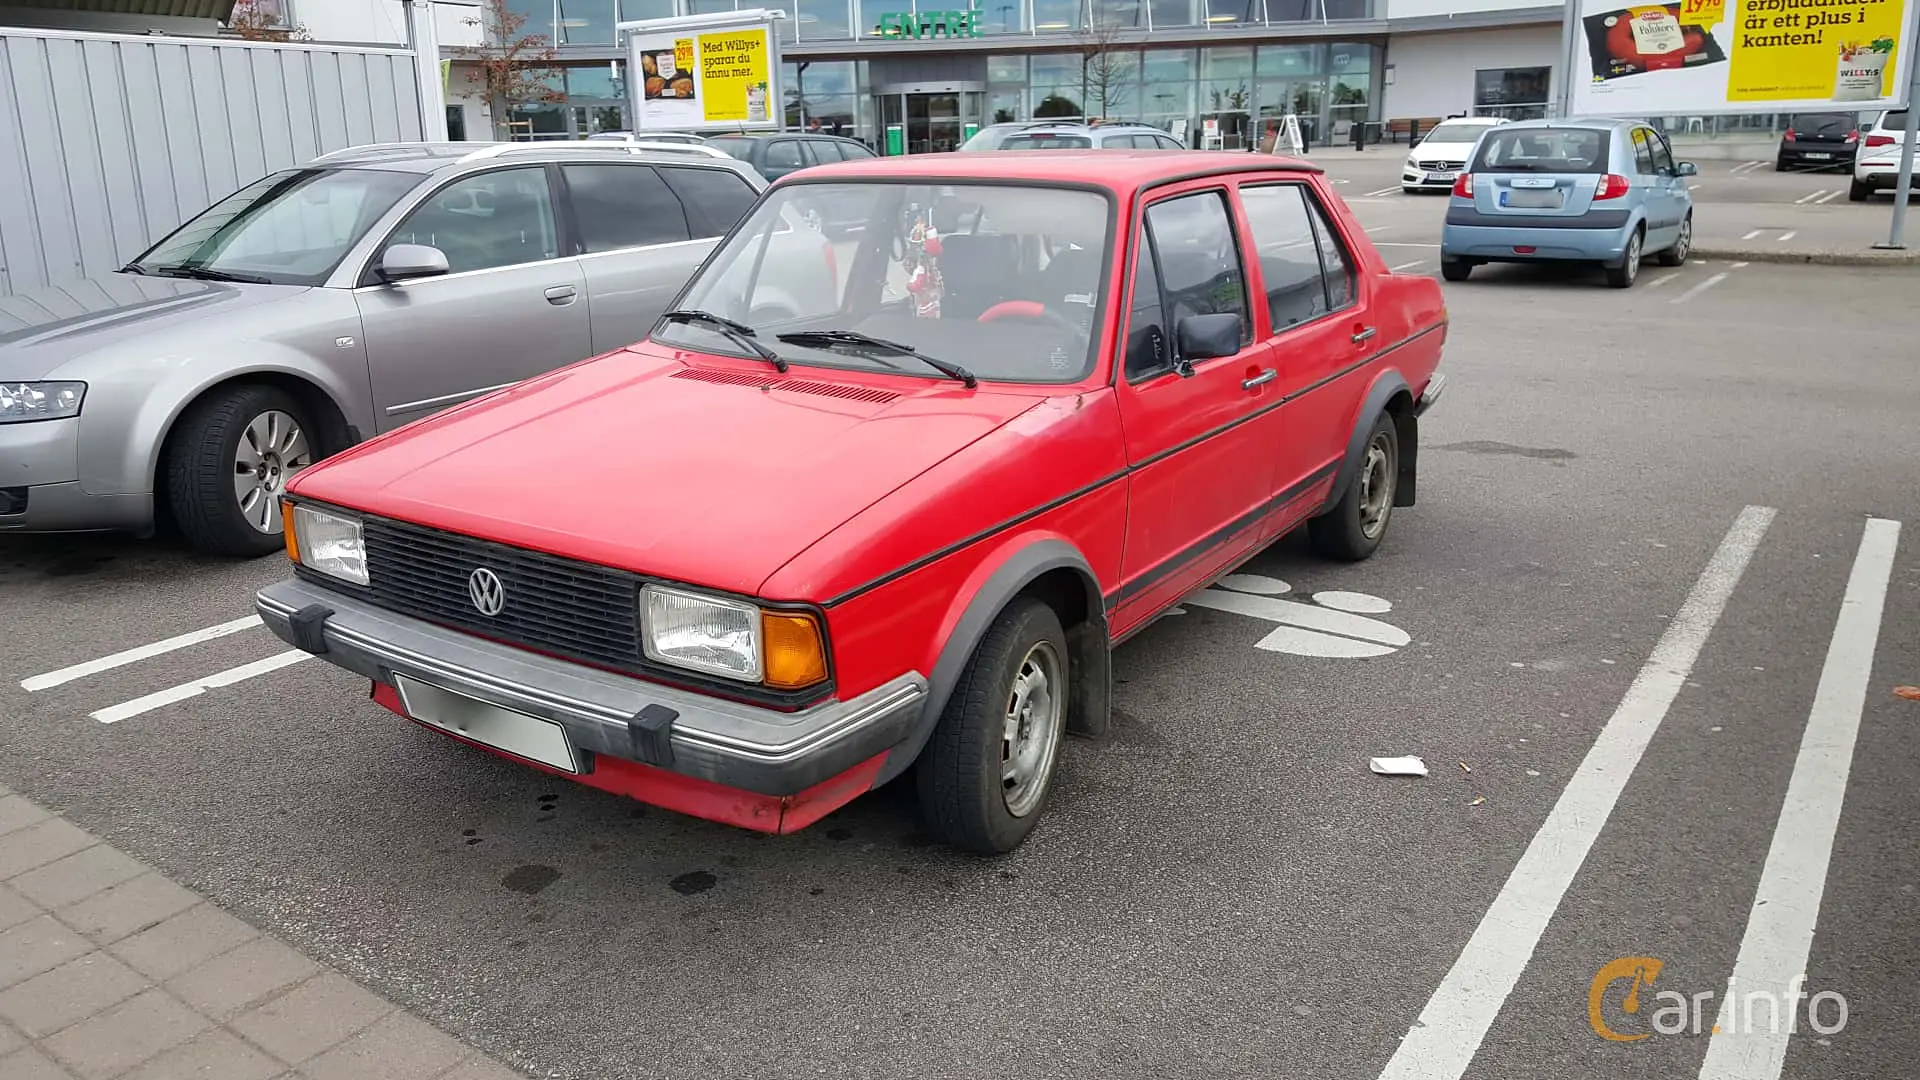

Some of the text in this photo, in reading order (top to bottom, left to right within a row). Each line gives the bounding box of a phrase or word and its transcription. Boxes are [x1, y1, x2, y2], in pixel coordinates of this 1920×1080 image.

[1746, 0, 1886, 12] erbjudan
[1744, 7, 1865, 30] är ett plus i
[1742, 29, 1824, 48] kanten!
[703, 39, 761, 53] Med Willys+
[704, 56, 735, 68] sparar
[737, 53, 750, 64] du
[705, 67, 753, 79] ännu mer.
